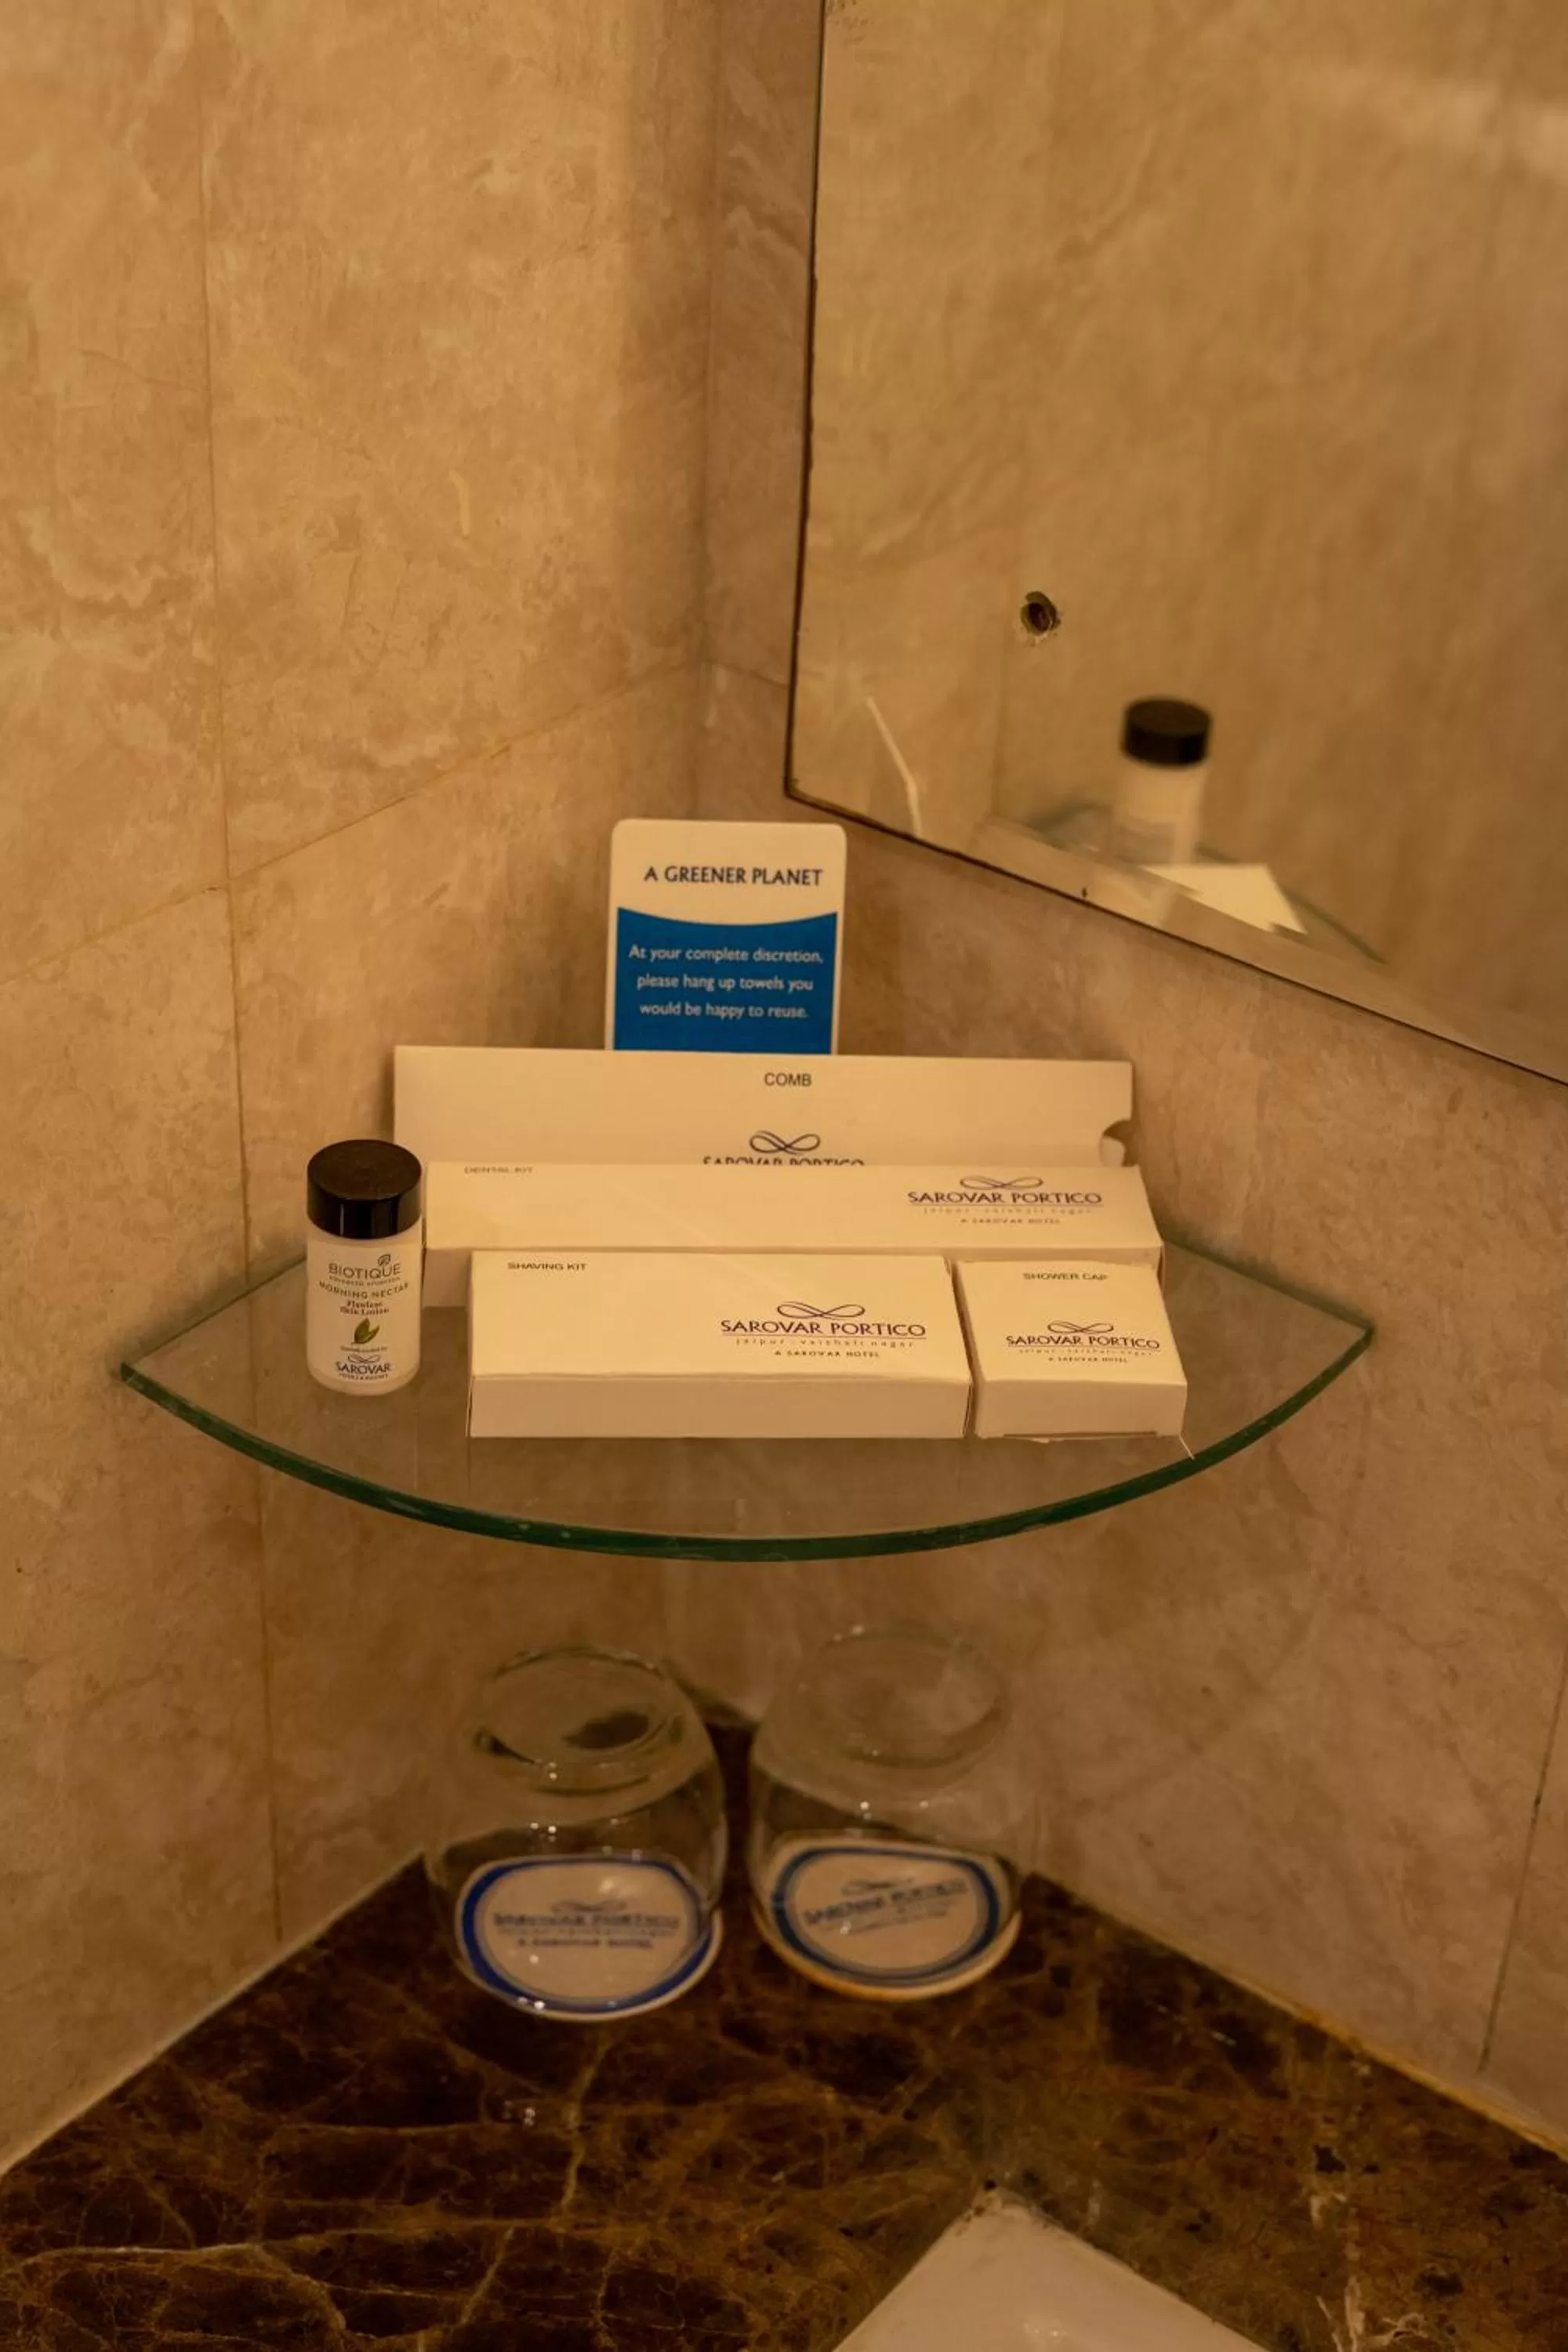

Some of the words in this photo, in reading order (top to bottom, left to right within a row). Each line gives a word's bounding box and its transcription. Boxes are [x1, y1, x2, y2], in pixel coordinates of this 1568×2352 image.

[644, 866, 658, 882] A
[664, 866, 746, 884] GREENER
[752, 868, 823, 886] PLANET
[628, 945, 646, 959] At
[650, 948, 681, 962] your
[685, 946, 749, 963] complete
[753, 946, 823, 964] discretion,
[637, 974, 678, 989] please
[683, 974, 715, 992] hang
[718, 979, 735, 992] up
[739, 975, 783, 989] towels
[788, 980, 814, 993] you
[639, 1001, 681, 1016] would
[684, 1002, 702, 1016] be
[706, 1003, 745, 1020] happy
[749, 1004, 764, 1018] to
[768, 1007, 808, 1018] reuse.
[764, 1072, 812, 1087] COMB
[907, 1191, 1004, 1204] SAROVAR
[1011, 1192, 1103, 1204] PORTICO
[328, 1262, 402, 1280] BIOTIQUE
[507, 1261, 564, 1270] SHAVING
[566, 1262, 589, 1271] KIT
[720, 1319, 823, 1334] SAROVAR
[831, 1322, 927, 1337] PORTICO
[1006, 1335, 1083, 1346] SAROVAR
[1088, 1335, 1160, 1350] PORTICO
[335, 1360, 391, 1374] SAROVAR
